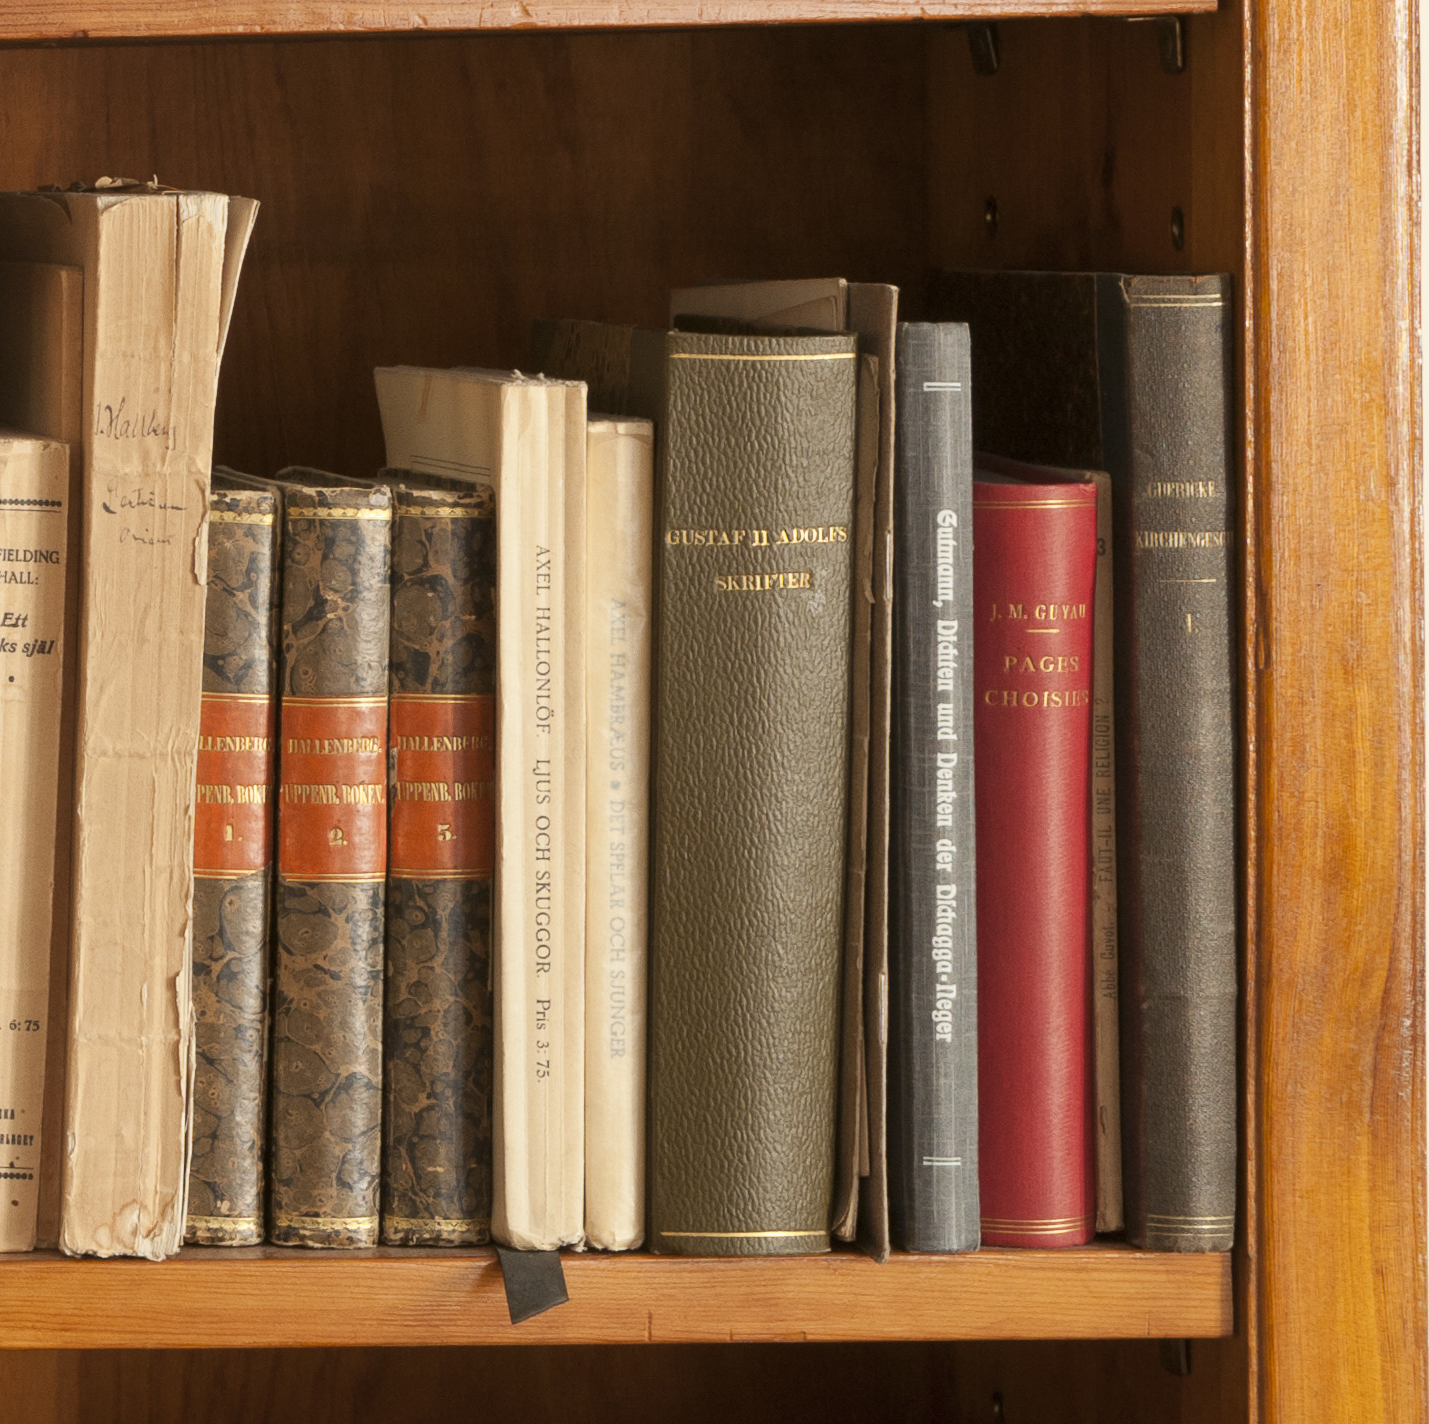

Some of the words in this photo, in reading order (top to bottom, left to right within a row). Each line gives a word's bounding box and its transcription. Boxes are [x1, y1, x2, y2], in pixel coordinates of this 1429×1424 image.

[666, 529, 744, 546] GUSTAF
[775, 526, 848, 545] ADOLFS
[535, 545, 551, 598] AXEL
[933, 510, 957, 607] Gutmann,
[716, 571, 811, 592] SKRIFTER
[0, 612, 28, 628] Ett
[1035, 604, 1086, 620] GUYAU
[22, 637, 54, 657] själ
[1003, 656, 1079, 672] PAGES
[535, 607, 553, 738] HALLONLÖF.
[984, 690, 1089, 708] CHOISIES
[937, 704, 957, 740] und
[534, 759, 552, 805] LJUS
[937, 752, 957, 828] Denken
[535, 816, 552, 862] OCH
[937, 839, 957, 874] der
[535, 870, 551, 978] SKUGGOR.
